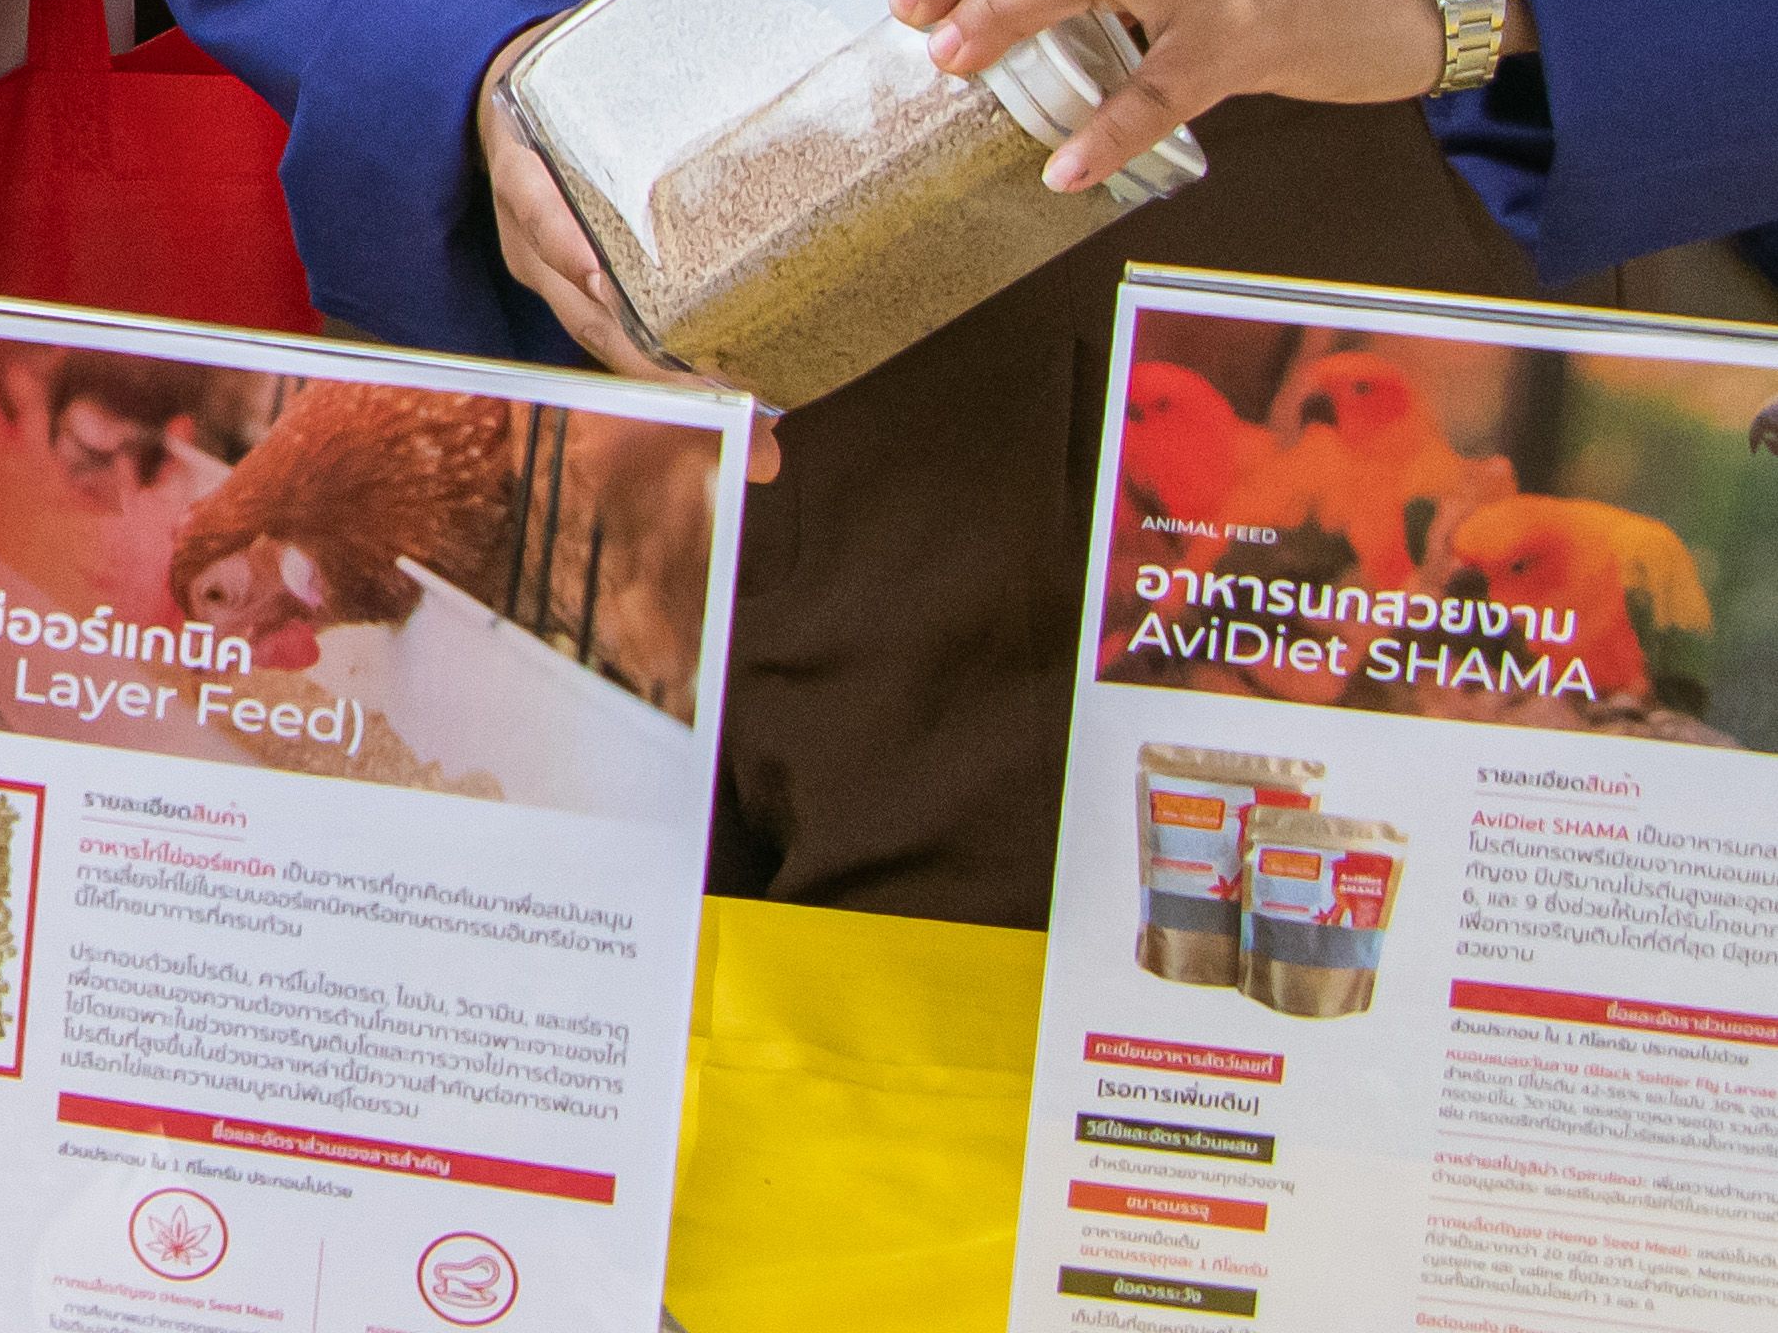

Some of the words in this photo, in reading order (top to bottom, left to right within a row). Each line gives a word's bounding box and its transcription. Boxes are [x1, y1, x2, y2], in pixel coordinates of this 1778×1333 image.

[1141, 513, 1221, 540] ANIMAL
[1224, 523, 1279, 546] FEED
[1135, 562, 1579, 649] อาหารนกสวยงาม
[1127, 611, 1354, 683] AviDiet
[1362, 634, 1596, 702] SHAMA
[16, 662, 178, 722] Layer
[195, 673, 370, 757] Feed)
[1471, 810, 1544, 832] AviDiet
[1553, 818, 1628, 841] SHAMA
